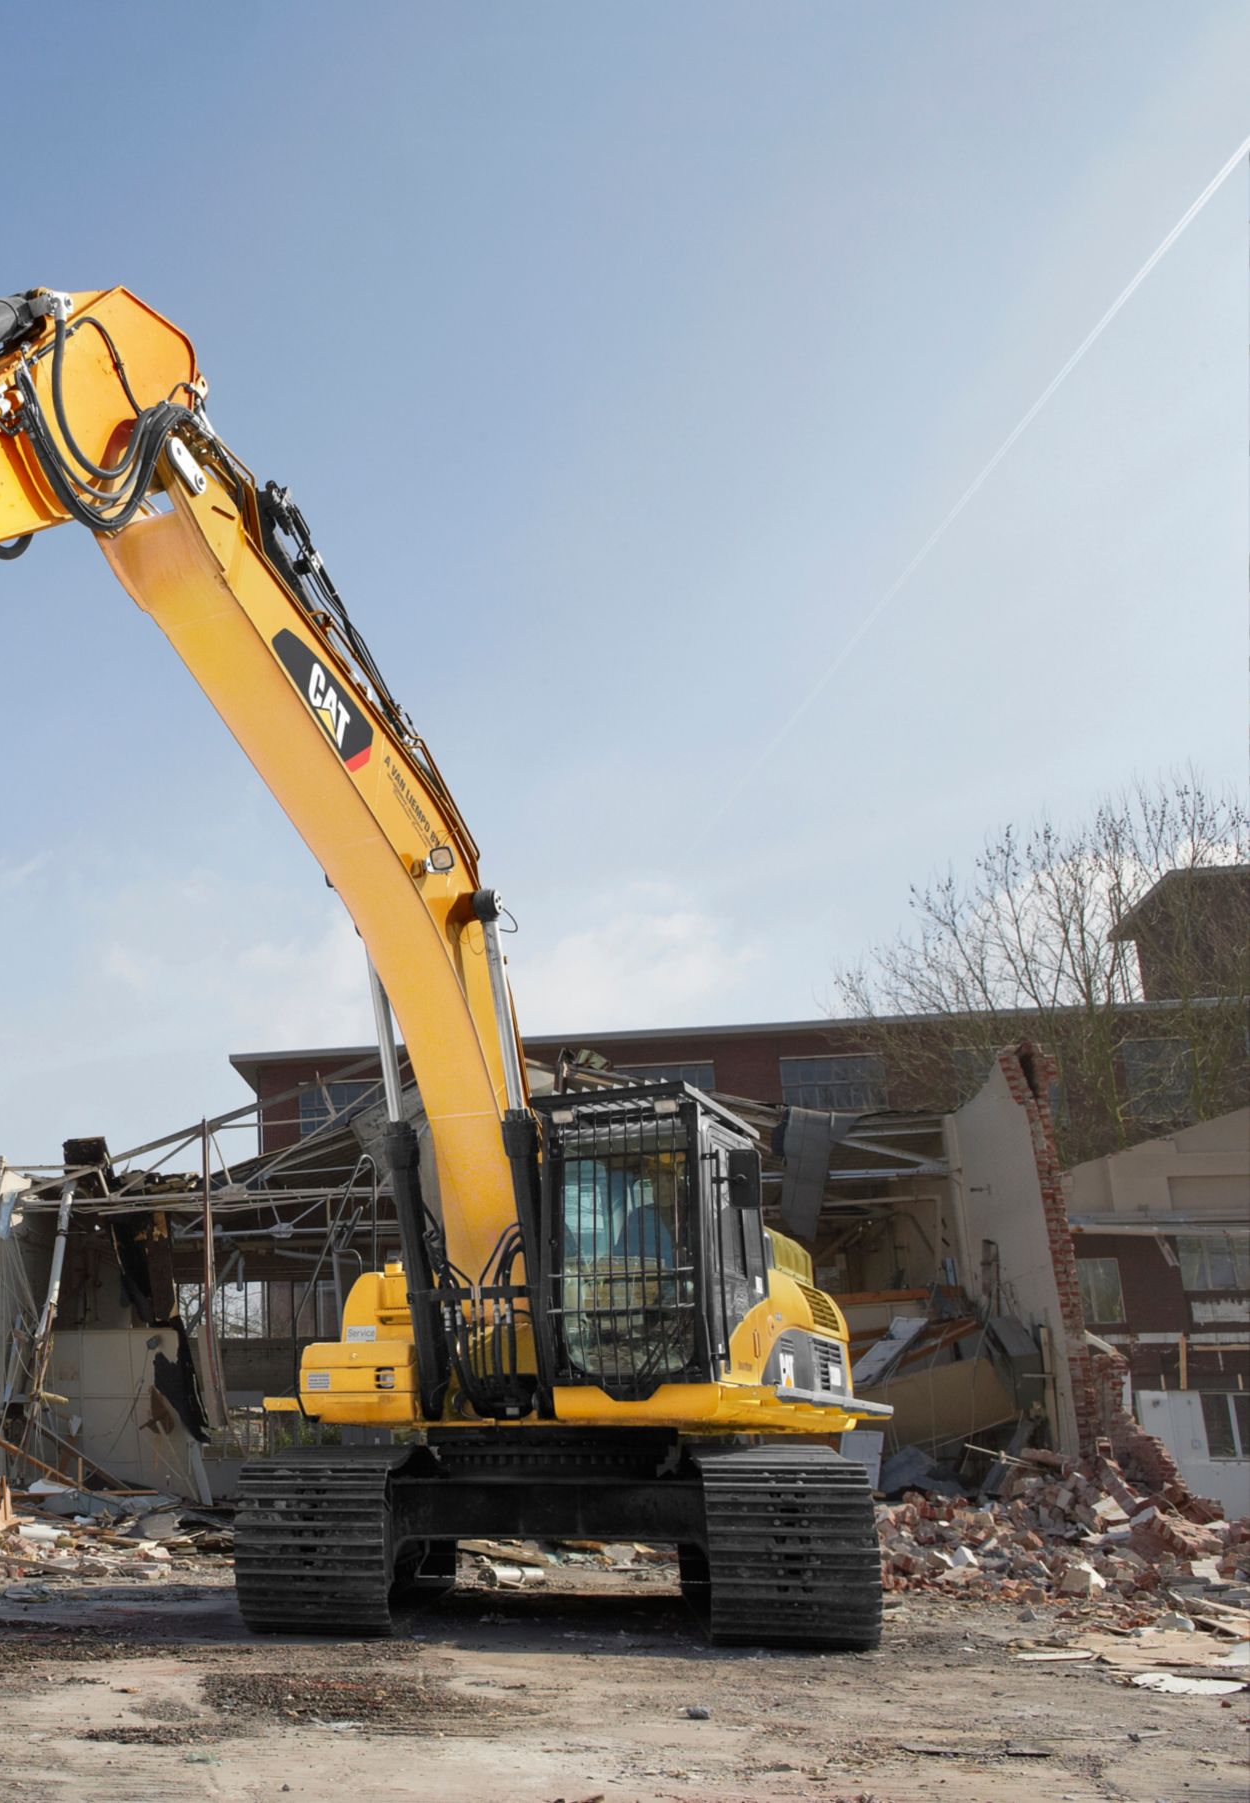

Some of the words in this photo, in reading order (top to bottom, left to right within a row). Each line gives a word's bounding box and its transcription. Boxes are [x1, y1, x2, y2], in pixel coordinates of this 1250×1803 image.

[308, 662, 351, 749] CAT
[384, 755, 391, 768] A
[391, 765, 407, 791] VAN
[347, 1328, 375, 1338] Service
